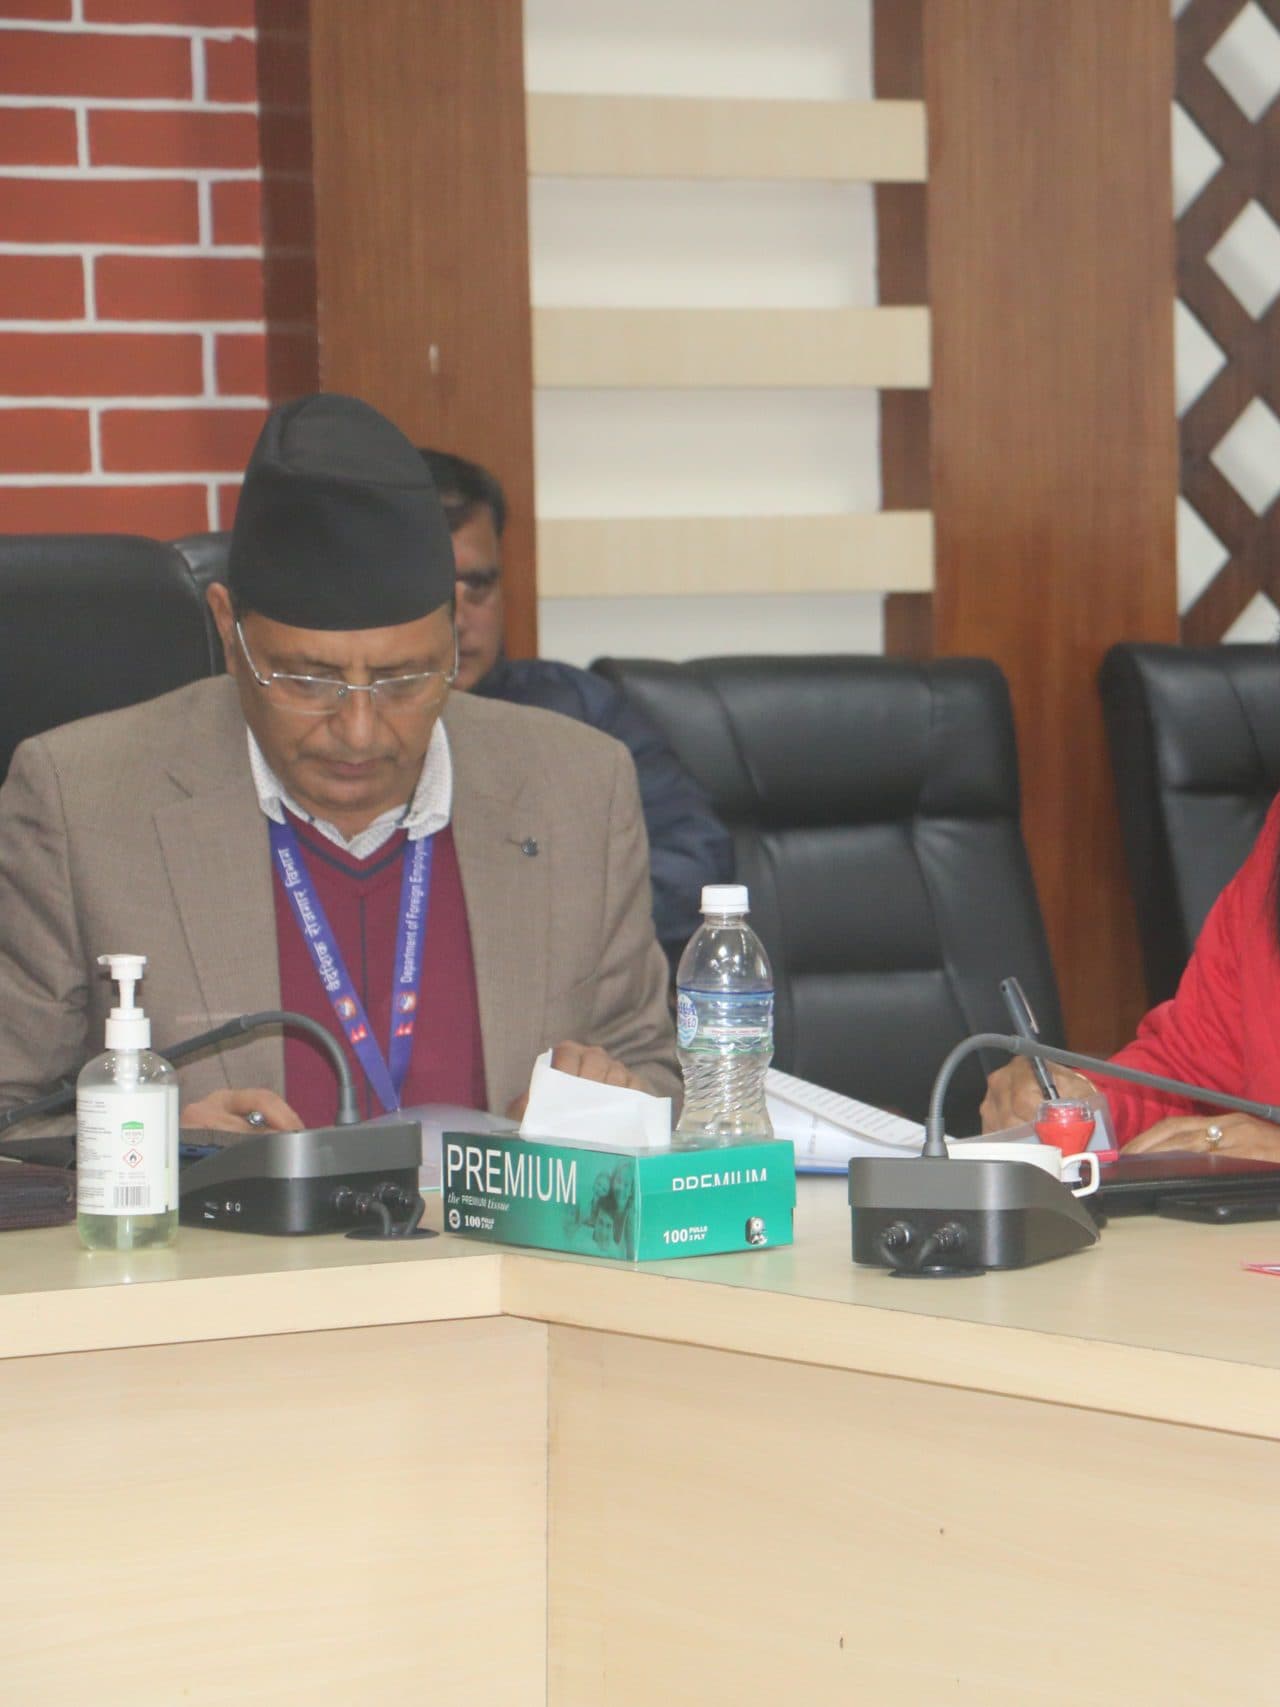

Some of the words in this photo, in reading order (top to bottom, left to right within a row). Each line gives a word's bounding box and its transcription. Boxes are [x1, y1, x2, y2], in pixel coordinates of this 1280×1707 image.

[406, 884, 424, 919] Foreign
[401, 931, 418, 983] Department
[447, 1143, 578, 1207] PREMIUM
[464, 1214, 481, 1229] 100
[663, 1228, 689, 1245] 100
